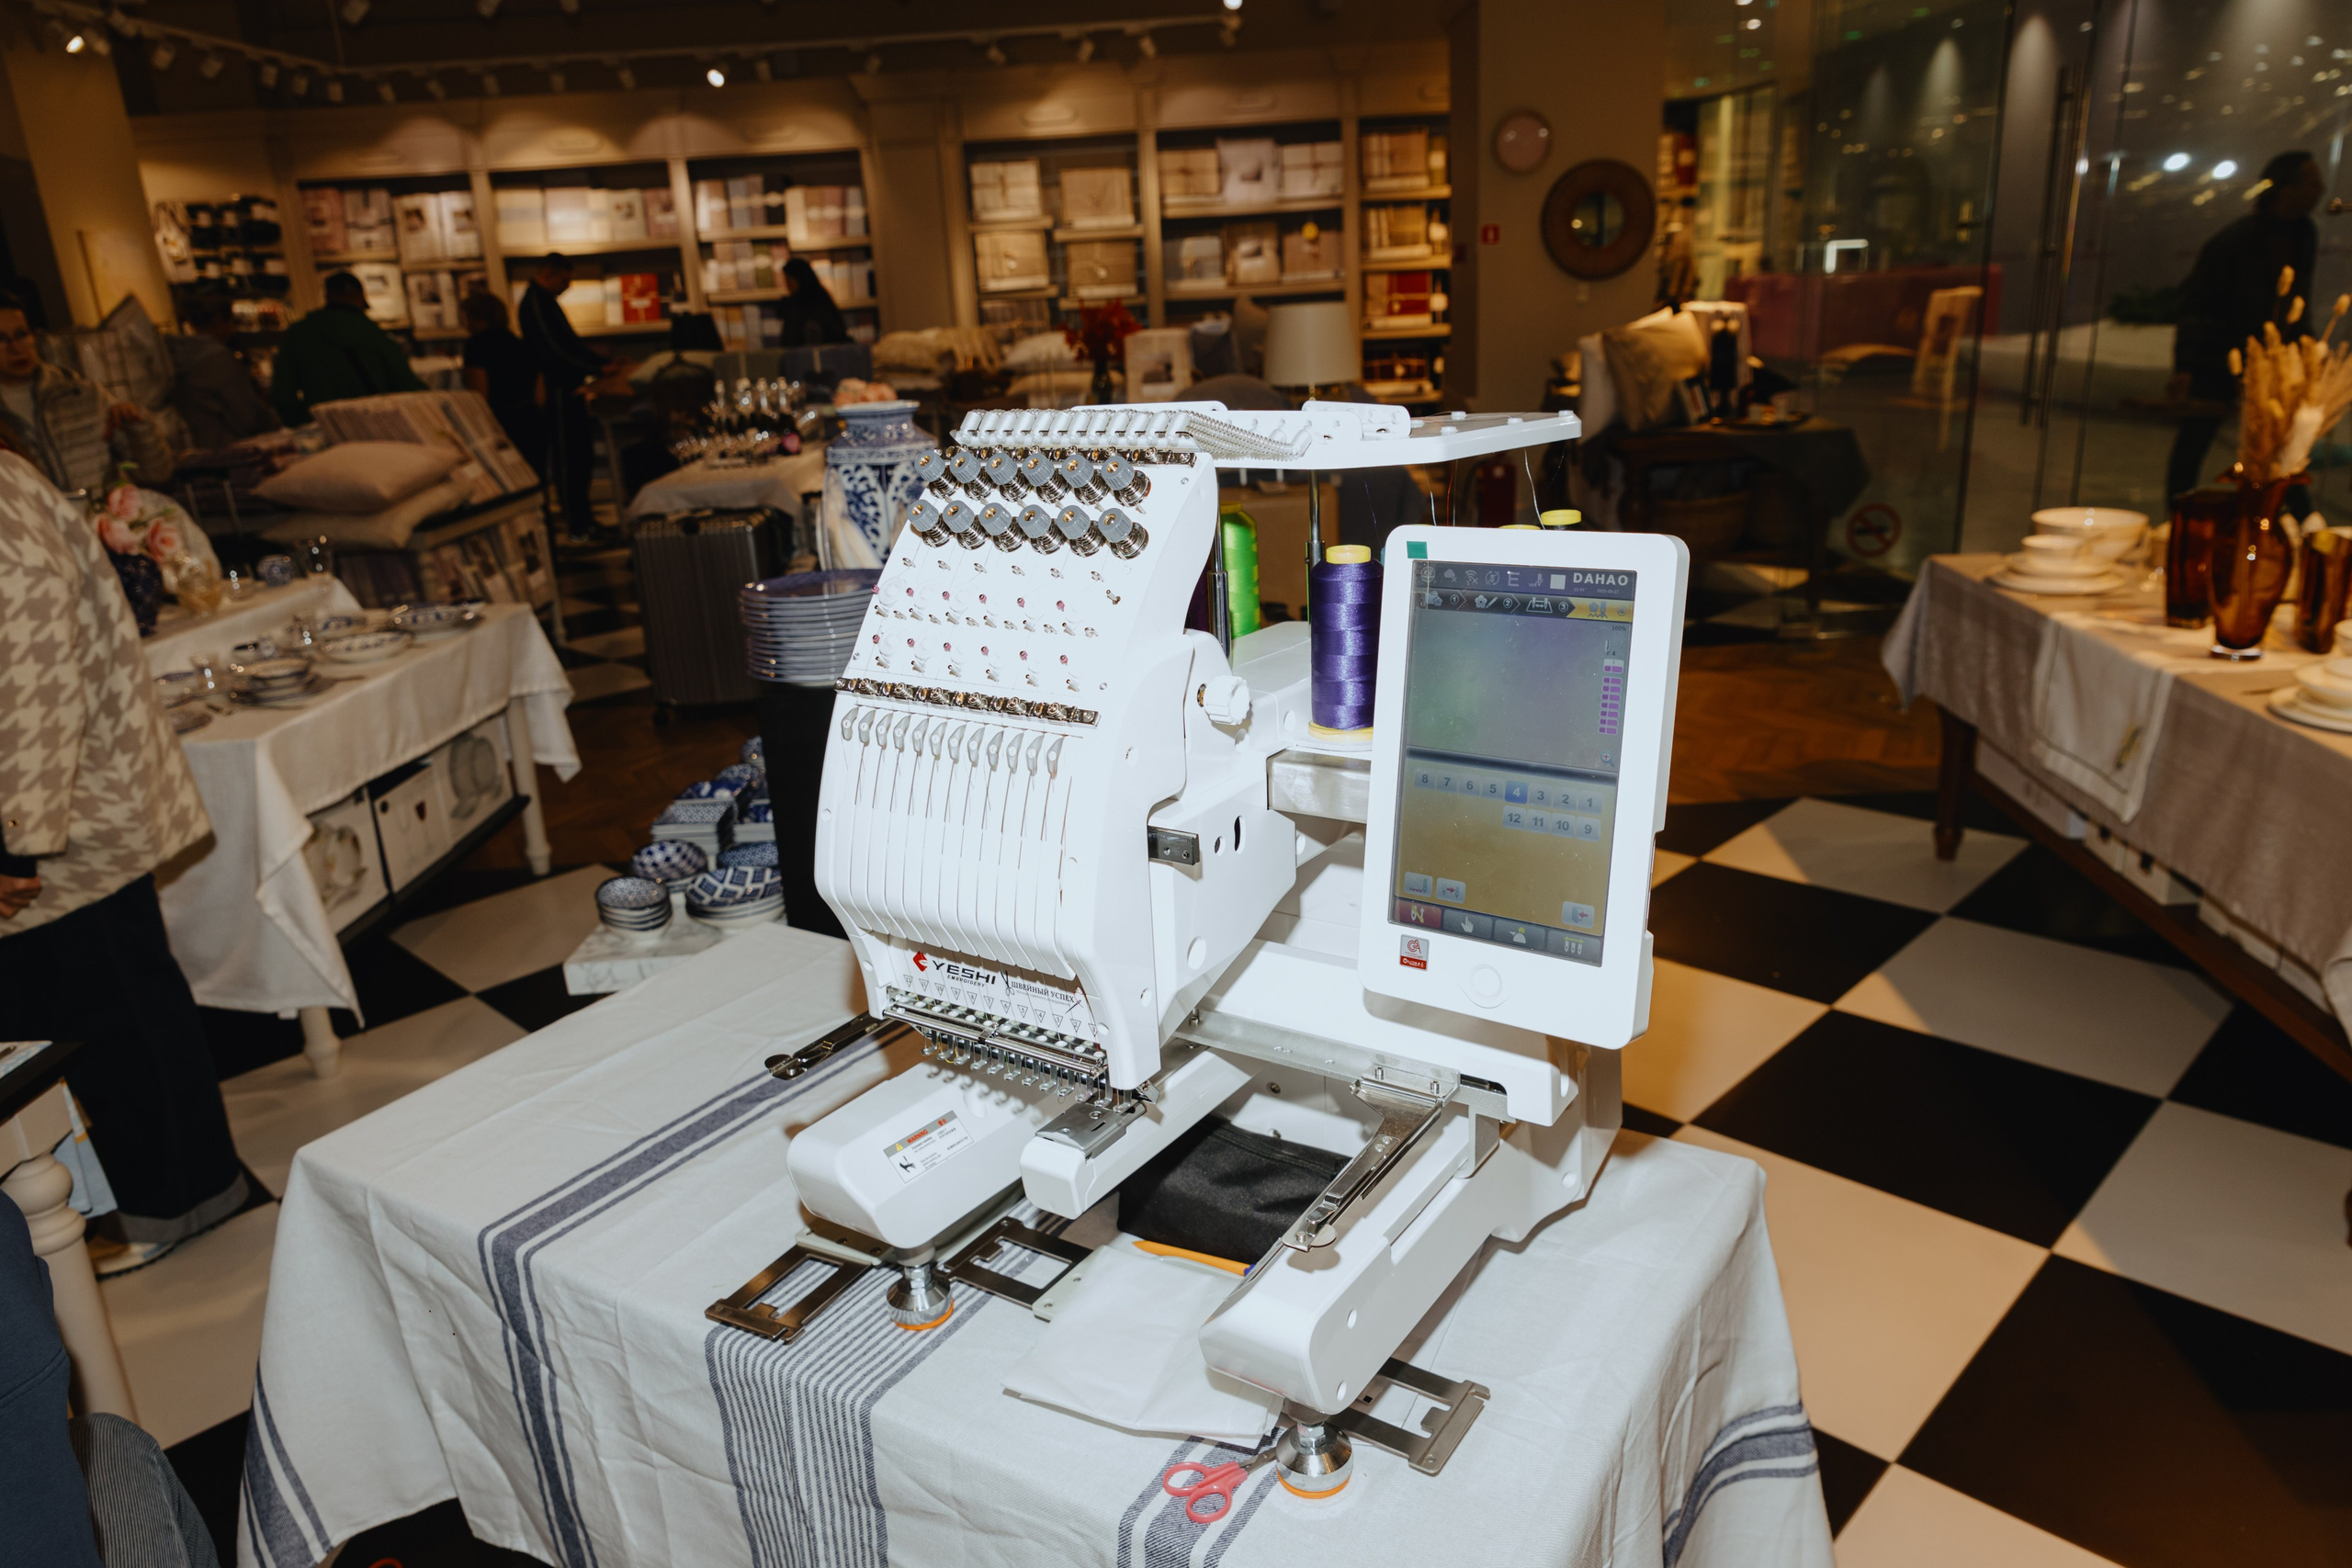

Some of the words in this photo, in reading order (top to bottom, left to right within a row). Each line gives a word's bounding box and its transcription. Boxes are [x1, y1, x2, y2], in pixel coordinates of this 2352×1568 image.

[1572, 572, 1629, 586] DAHAO
[1421, 774, 1429, 784] 8
[1443, 778, 1452, 786] 7
[1466, 781, 1474, 790] 6
[1489, 784, 1497, 794] 5
[1512, 787, 1521, 797] 4
[1537, 791, 1544, 801] 3
[1562, 795, 1569, 805] 2
[1586, 798, 1593, 808] 1
[1507, 813, 1521, 824] 12
[1532, 817, 1544, 827] 11
[1555, 820, 1570, 831] 10
[1584, 824, 1592, 835] 9
[933, 960, 996, 985] YESHI
[947, 975, 985, 987] EMBROIDERY
[1011, 980, 1049, 996] ШВЕЙНЫЙ
[1051, 991, 1075, 1003] УСПЕХ
[907, 1129, 928, 1144] WARNING
